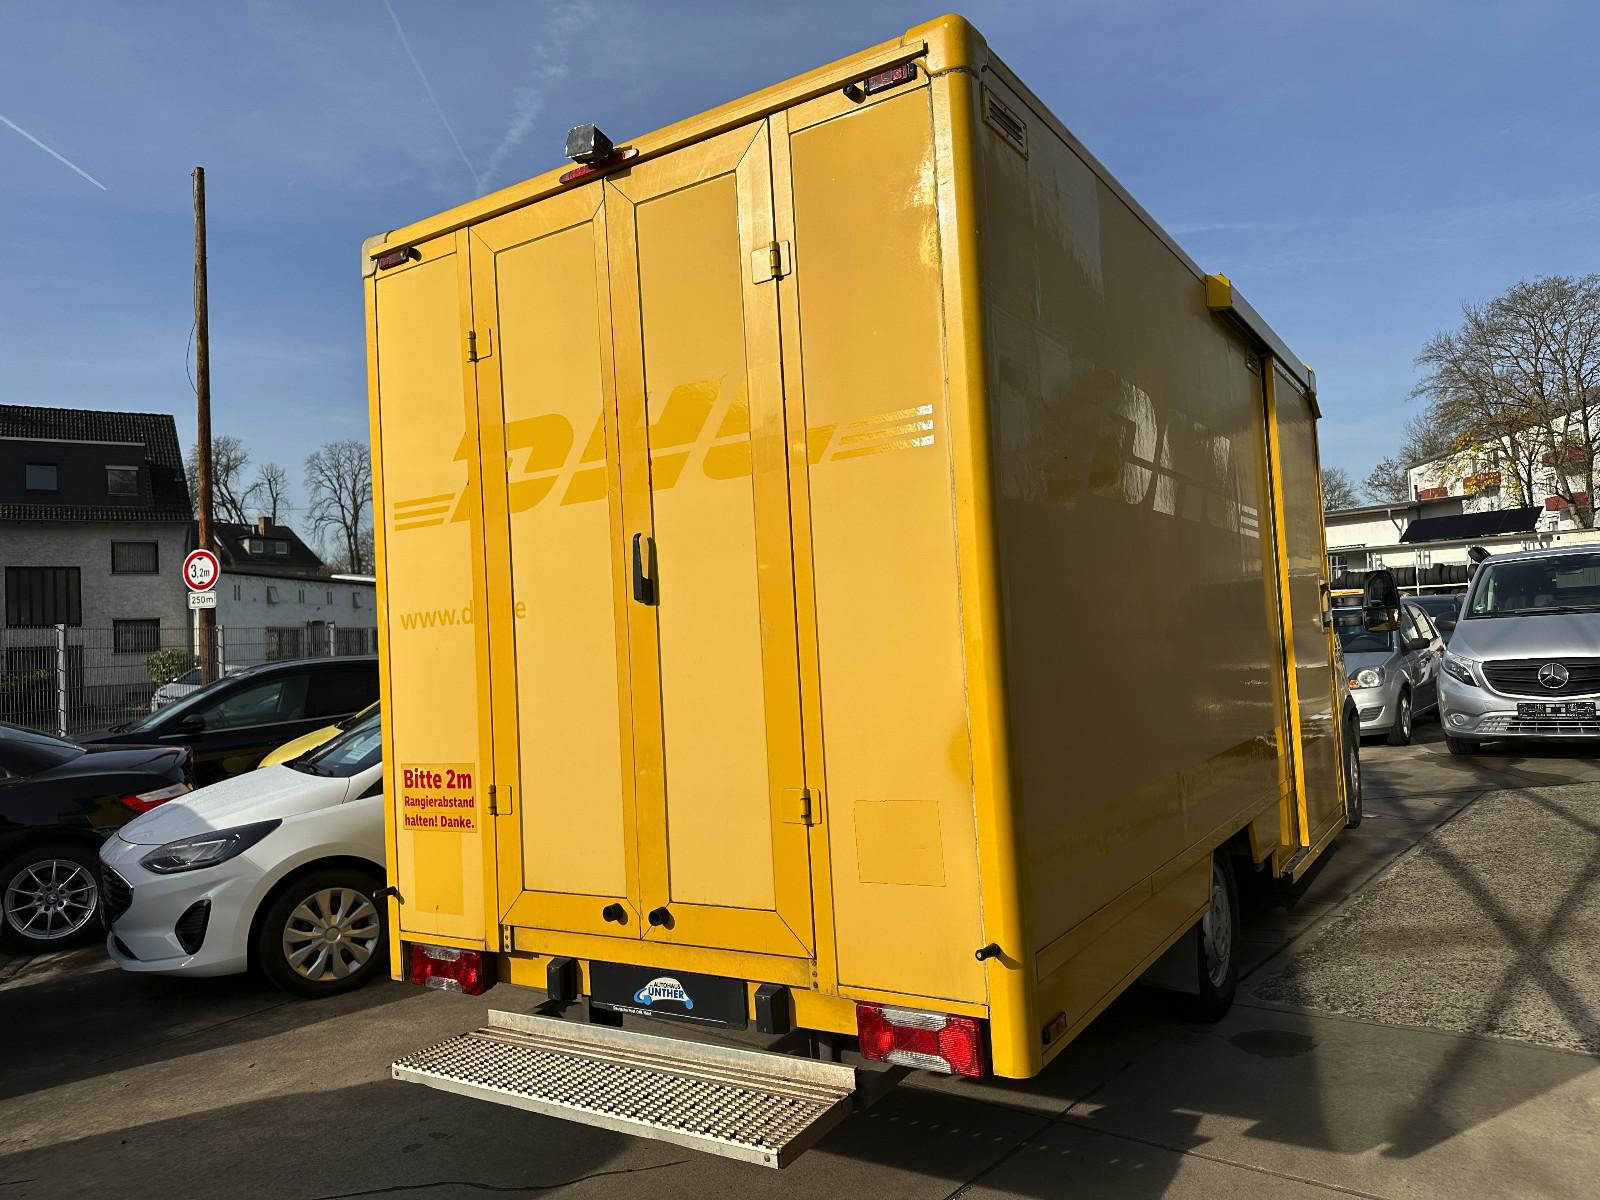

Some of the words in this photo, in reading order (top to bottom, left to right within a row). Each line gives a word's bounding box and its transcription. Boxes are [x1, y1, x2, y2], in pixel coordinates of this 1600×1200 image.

[450, 376, 838, 523] DHL
[400, 599, 526, 631] www.de
[403, 767, 442, 790] Bitte
[446, 769, 472, 789] 2m
[404, 795, 475, 810] Rangierabstand
[404, 813, 438, 827] halten!
[440, 815, 475, 829] Danke.
[653, 981, 681, 990] AUTOHAUS
